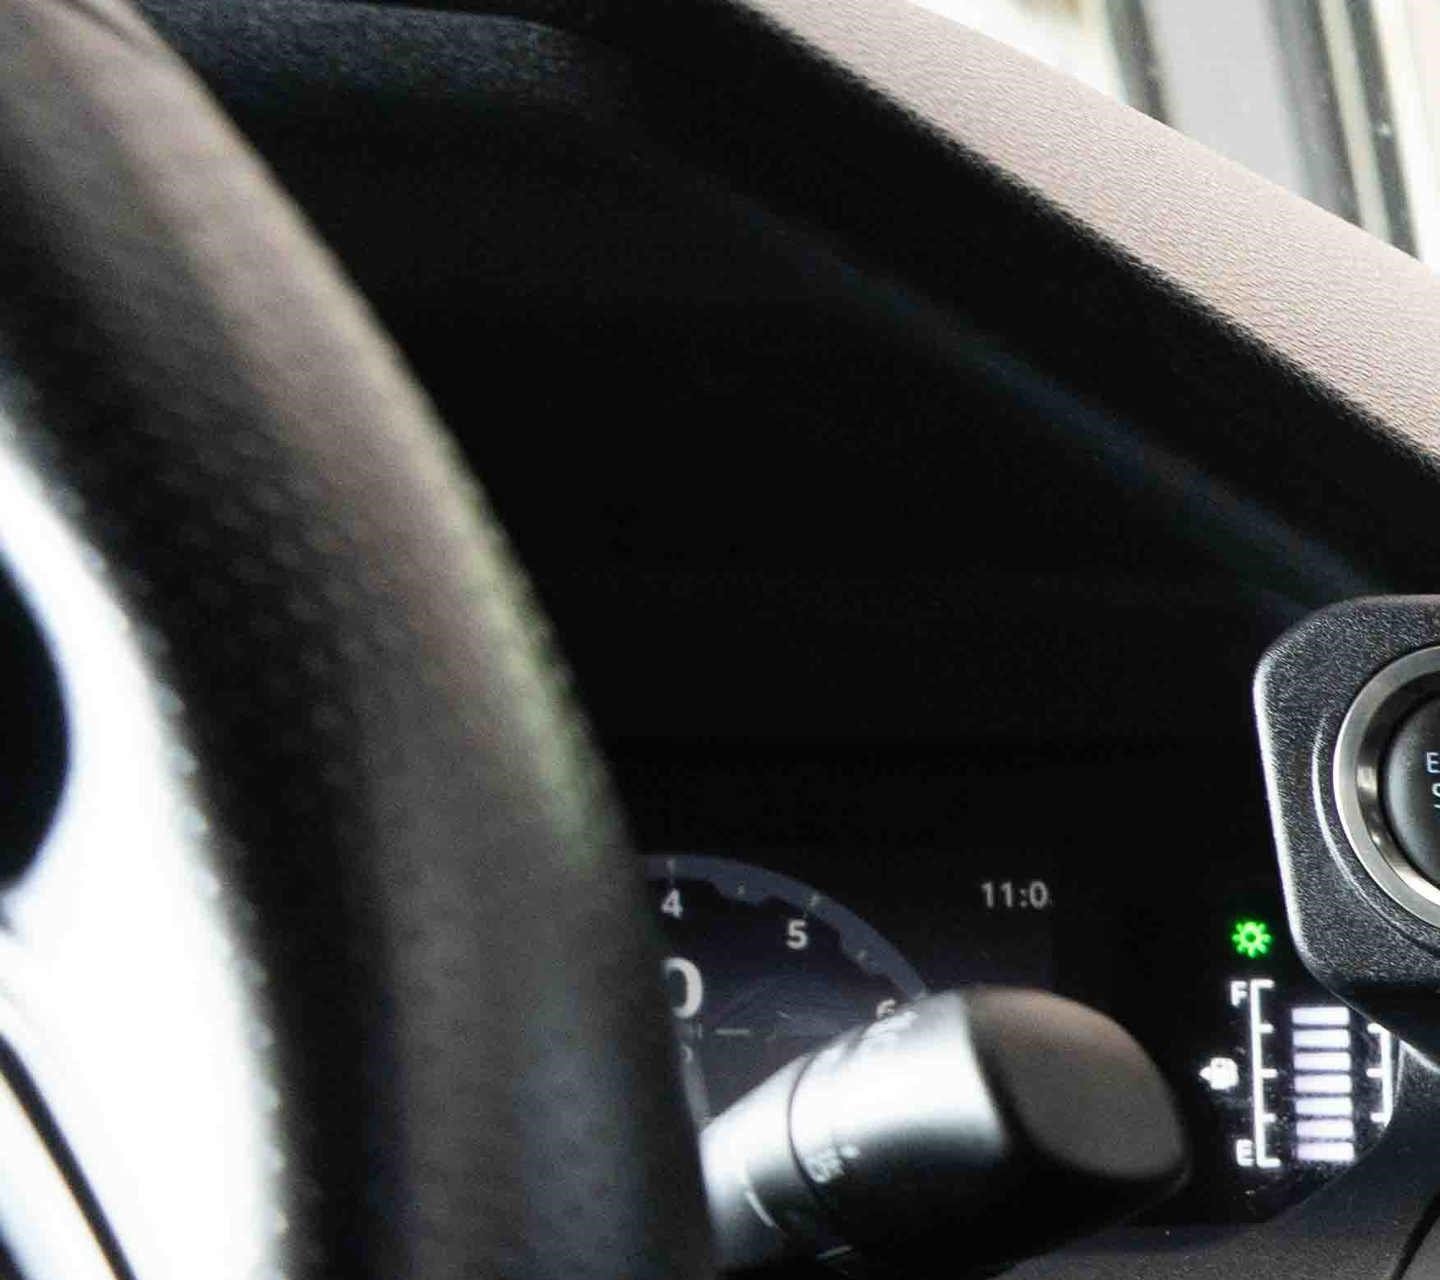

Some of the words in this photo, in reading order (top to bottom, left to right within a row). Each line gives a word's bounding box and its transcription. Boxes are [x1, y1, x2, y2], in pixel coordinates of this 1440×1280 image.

[660, 888, 684, 919] 4
[786, 918, 810, 951] 5
[1229, 979, 1248, 1008] F
[1234, 1137, 1255, 1168] E
